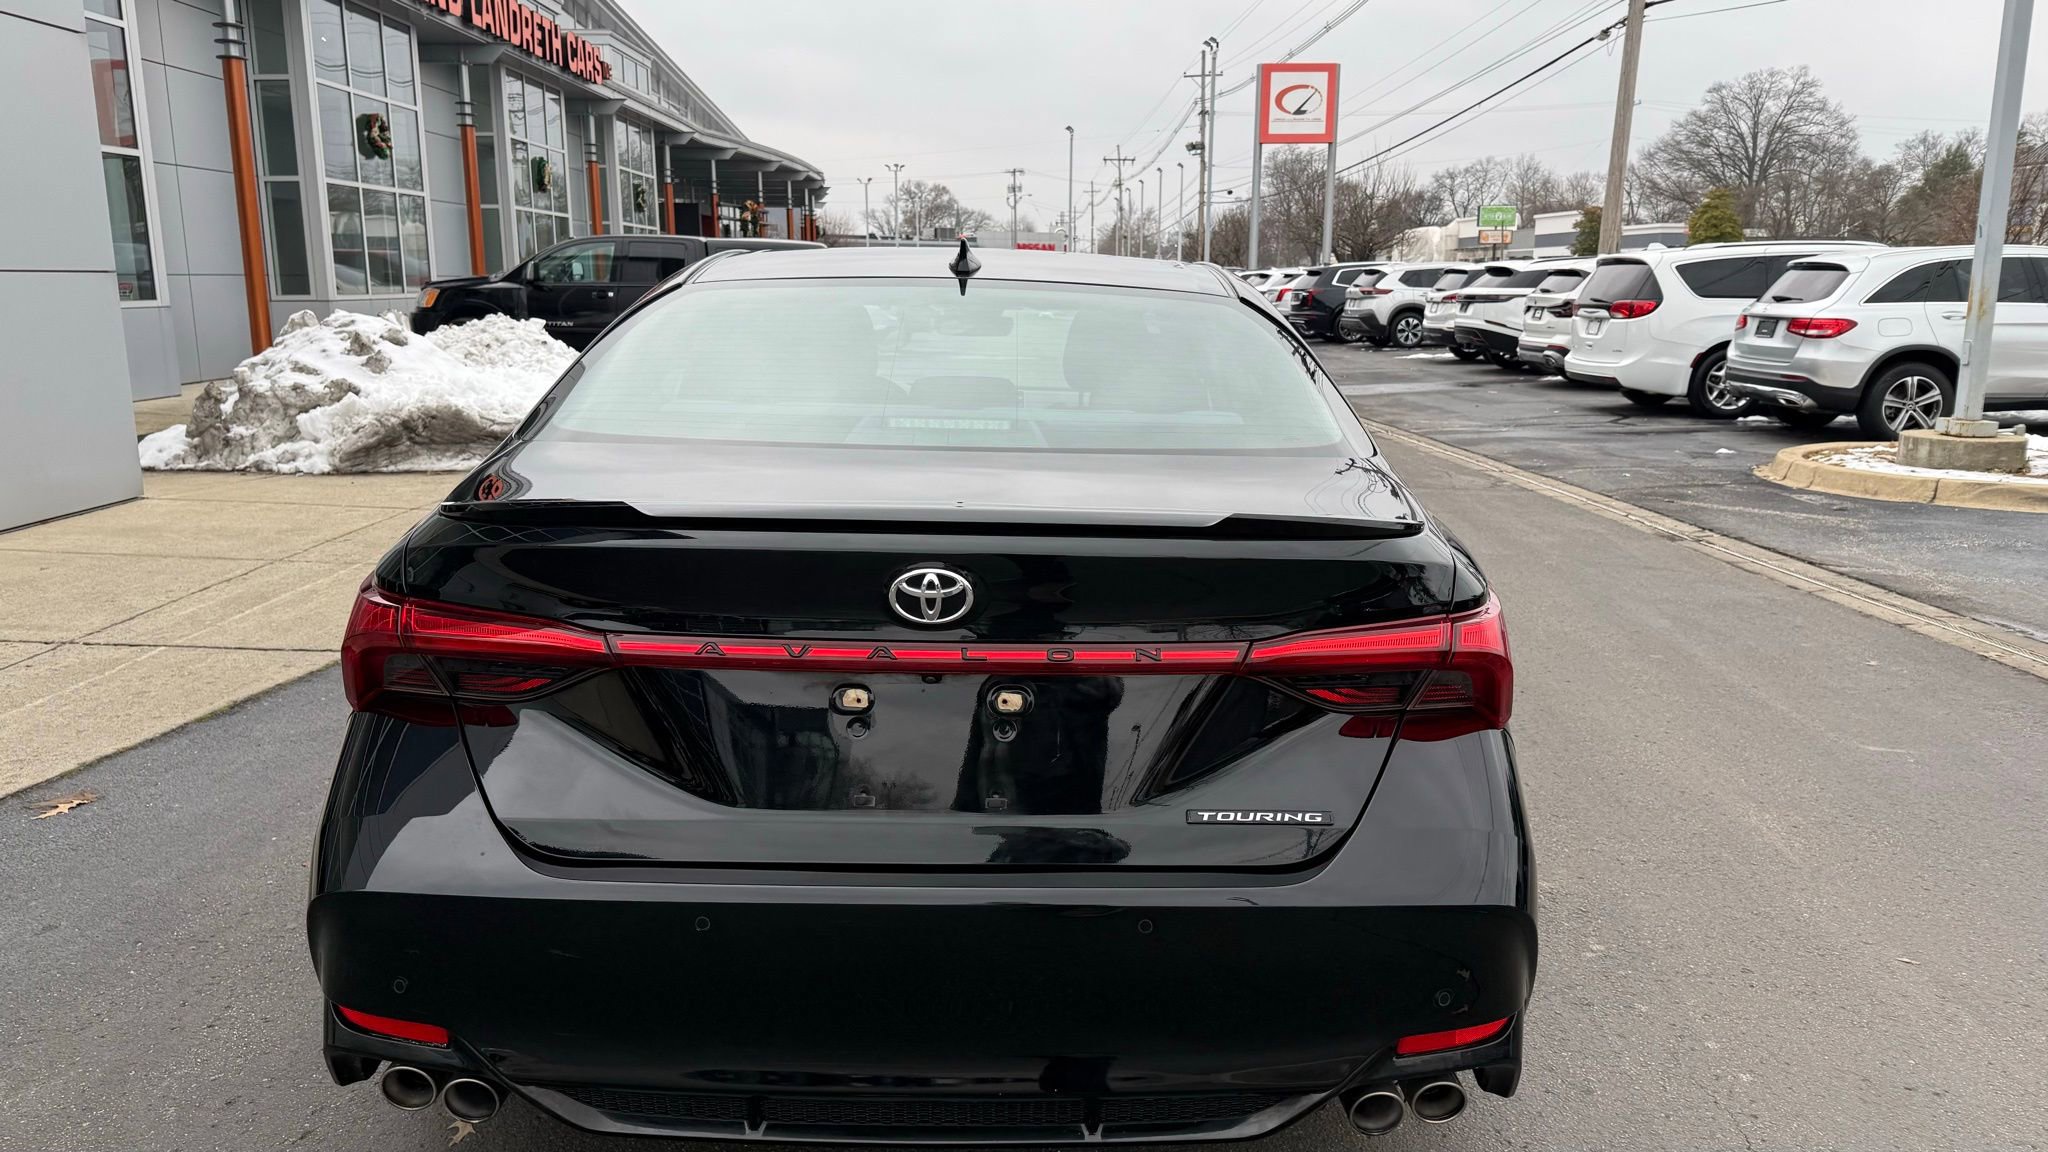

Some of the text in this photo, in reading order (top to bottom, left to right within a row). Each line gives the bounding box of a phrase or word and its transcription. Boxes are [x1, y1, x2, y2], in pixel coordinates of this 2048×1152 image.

[471, 0, 563, 67] LANDRETH
[566, 31, 603, 85] CARS
[694, 641, 1163, 662] AVALON
[1197, 811, 1323, 822] TOURING
